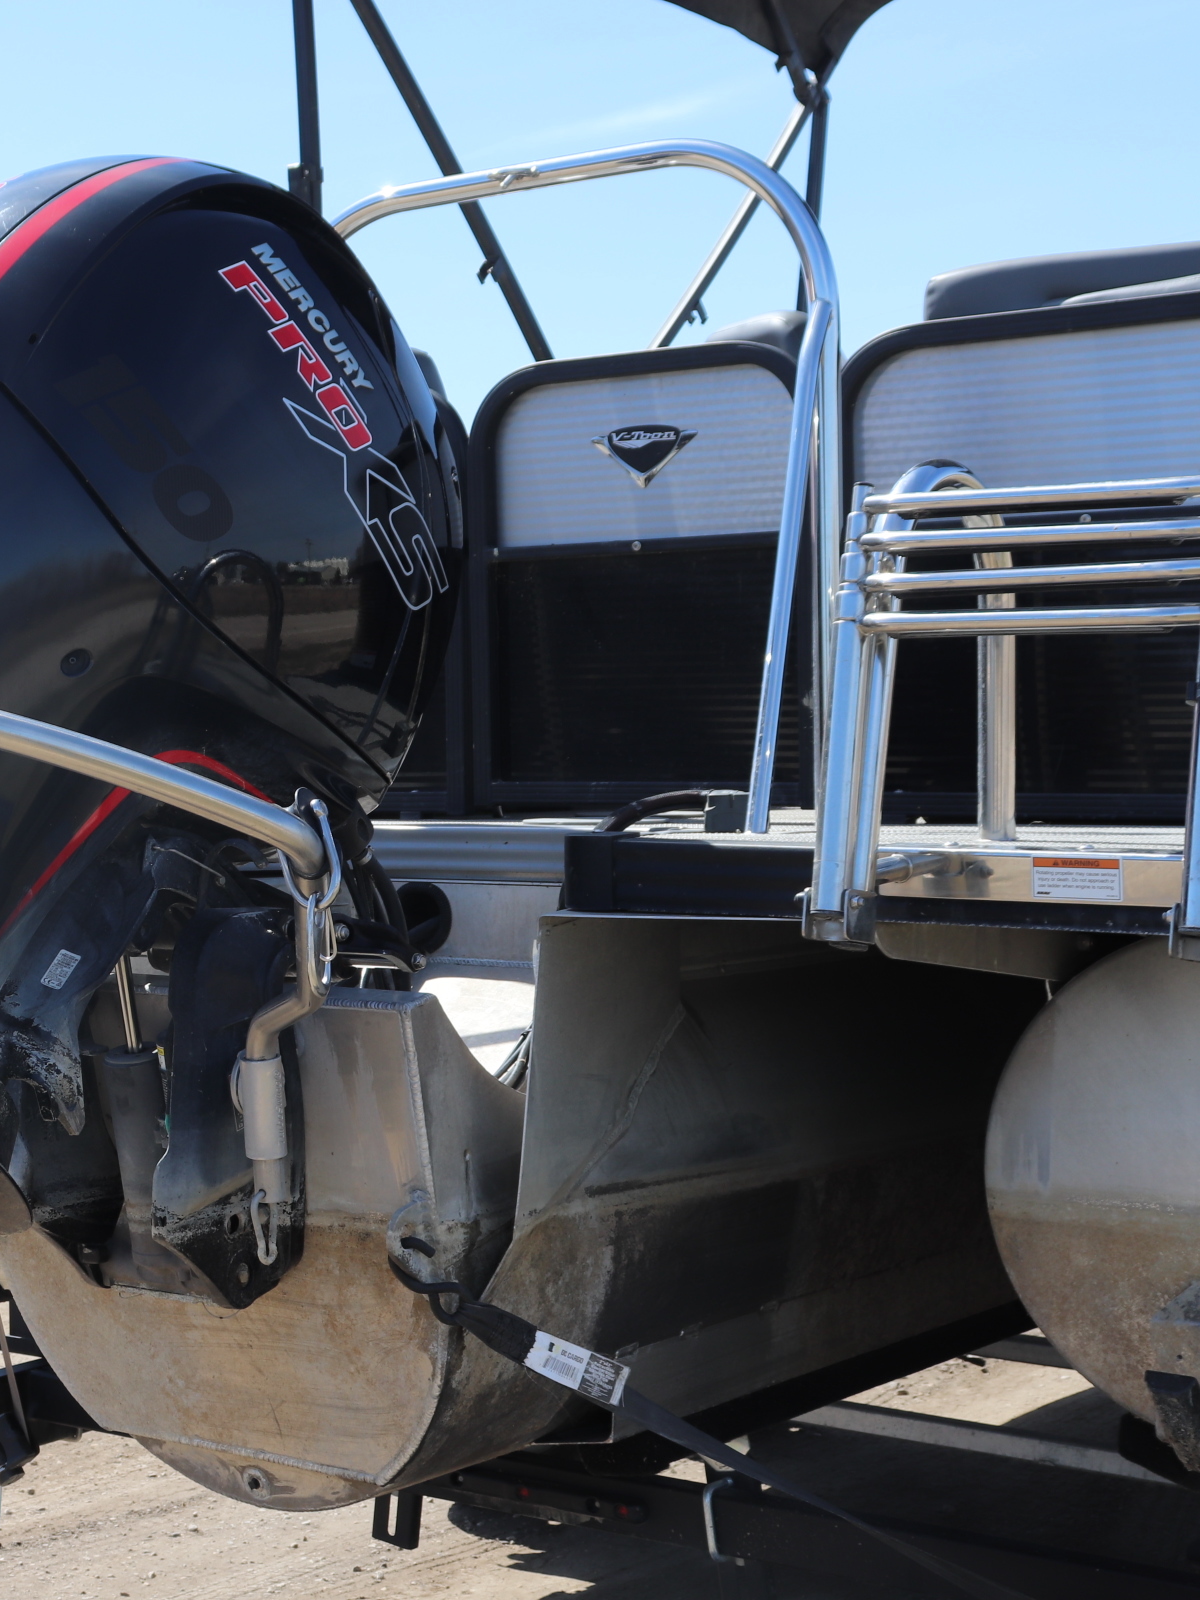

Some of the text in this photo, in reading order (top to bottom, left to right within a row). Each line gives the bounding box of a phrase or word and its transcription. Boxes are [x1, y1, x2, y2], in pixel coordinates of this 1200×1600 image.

[251, 242, 374, 392] MERCURY
[218, 260, 373, 451] PRO
[611, 431, 677, 441] V-Toon
[1061, 859, 1100, 867] WARNING
[566, 1351, 584, 1364] CARGO
